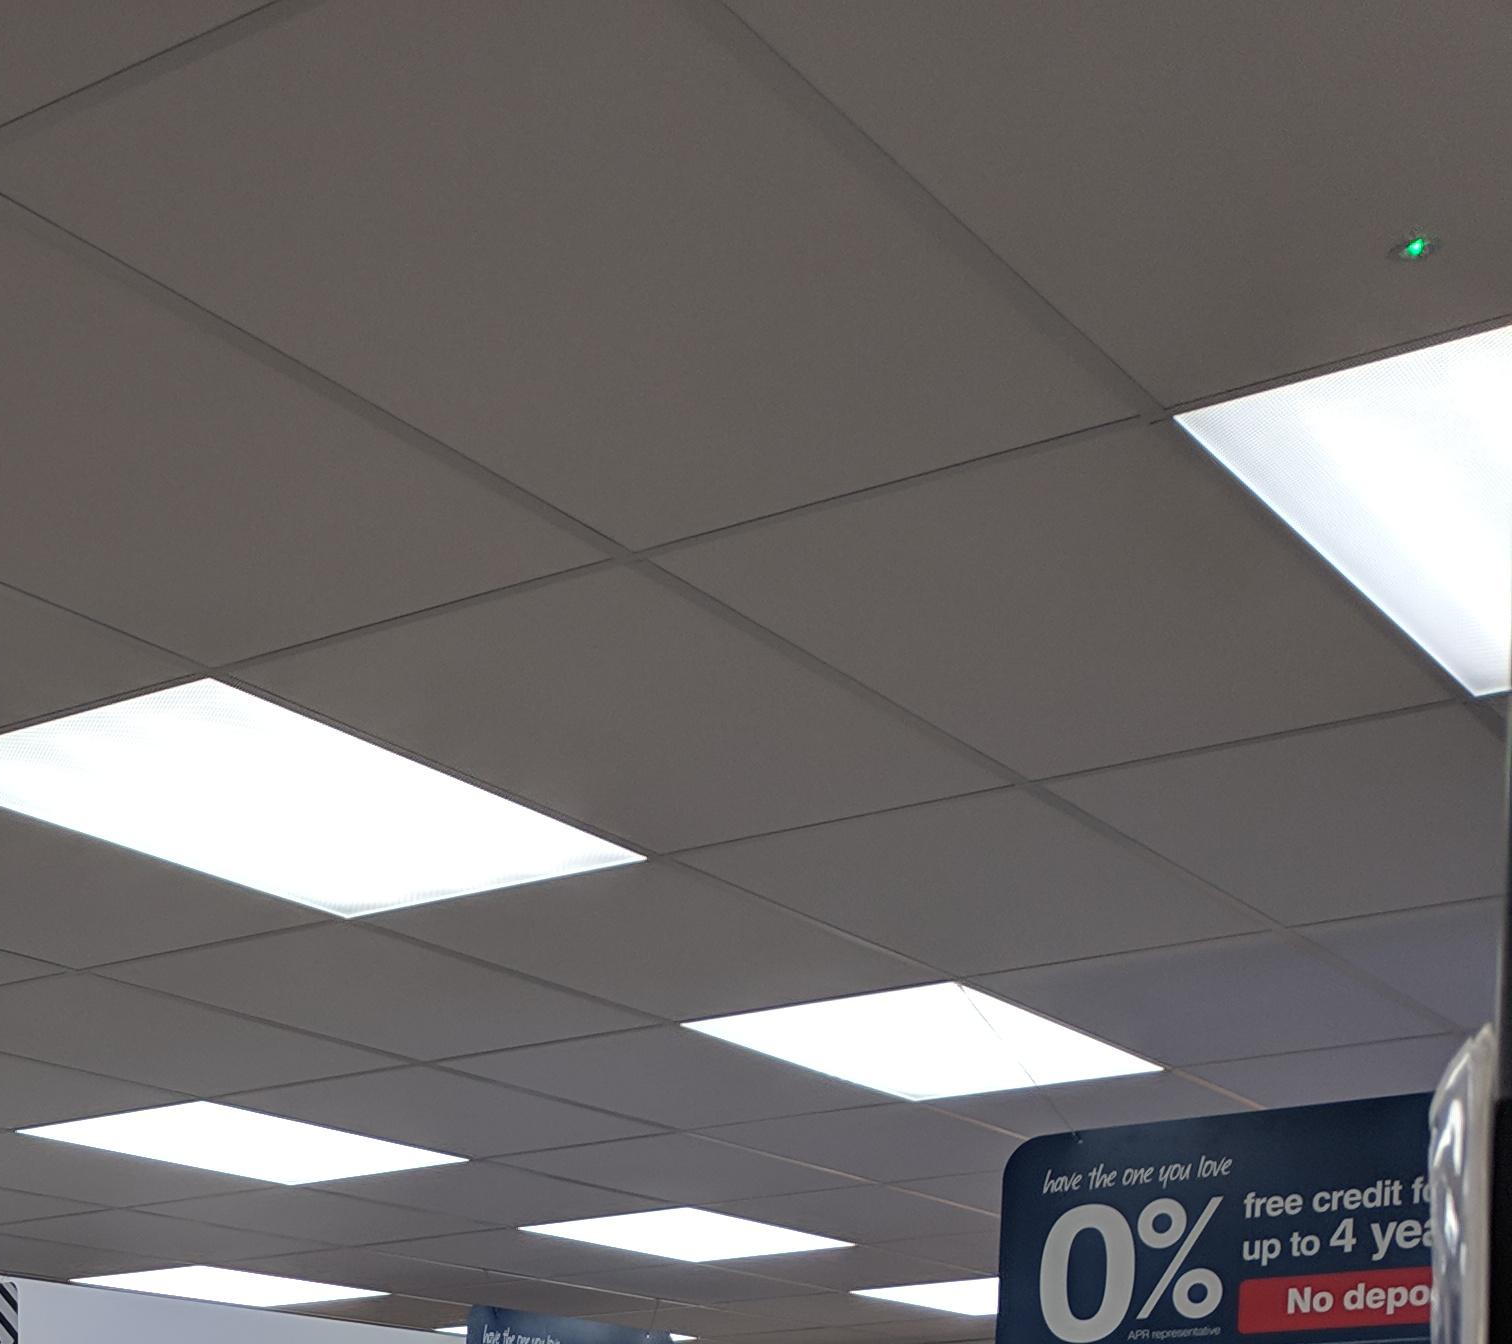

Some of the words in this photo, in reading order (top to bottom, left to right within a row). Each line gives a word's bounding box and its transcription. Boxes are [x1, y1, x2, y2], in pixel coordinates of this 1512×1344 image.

[1243, 1191, 1303, 1219] free
[1312, 1179, 1403, 1213] credit
[1242, 1237, 1281, 1267] up
[1289, 1231, 1320, 1257] to
[1329, 1217, 1357, 1253] 4
[1039, 1195, 1225, 1344] 0%
[1286, 1286, 1334, 1315] No
[1343, 1282, 1431, 1315] depo
